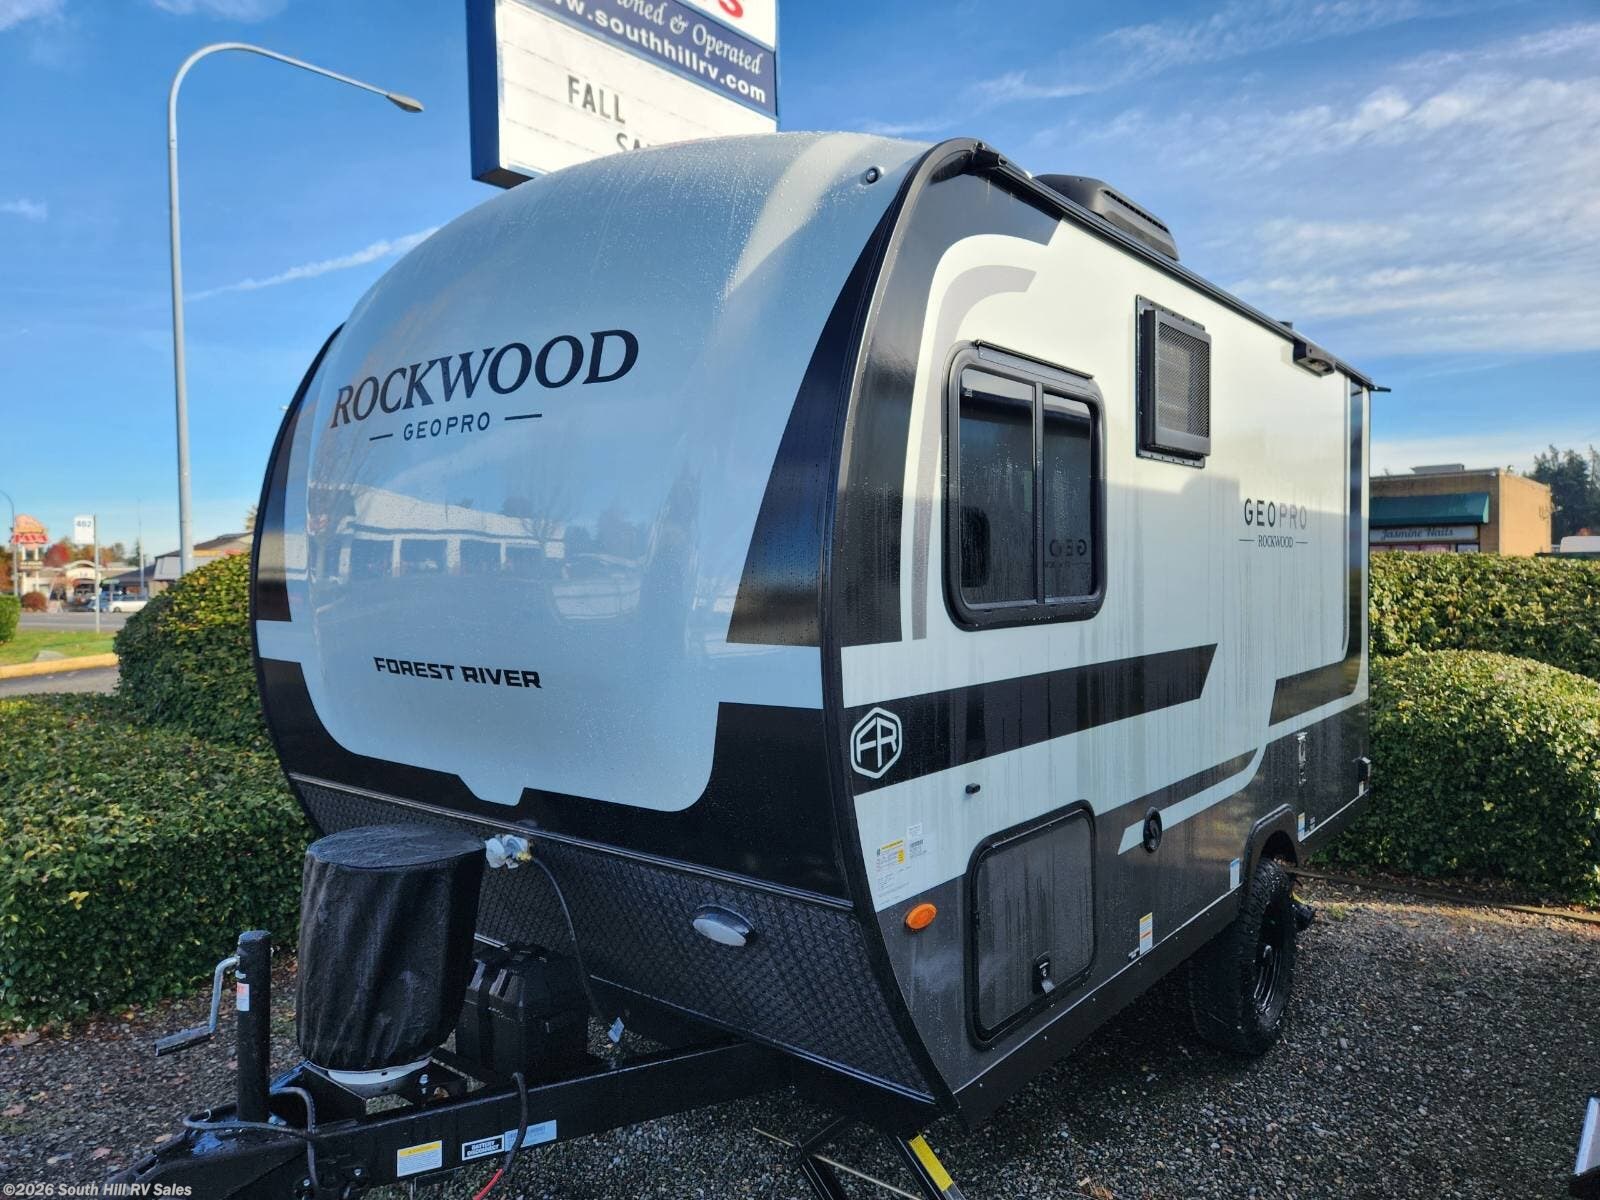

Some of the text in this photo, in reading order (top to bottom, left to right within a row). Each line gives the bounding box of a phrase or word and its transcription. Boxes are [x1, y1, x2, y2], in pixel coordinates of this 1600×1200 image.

[670, 15, 688, 34] &
[692, 24, 763, 74] Operated
[567, 74, 626, 125] FALL
[330, 329, 639, 428] ROCKWOOD
[403, 411, 490, 441] GEOPRO
[1244, 498, 1307, 530] GEOPRO
[1258, 534, 1294, 549] ROCKWOOD
[1426, 525, 1454, 537] Nails
[374, 656, 542, 688] FOREST RIVER
